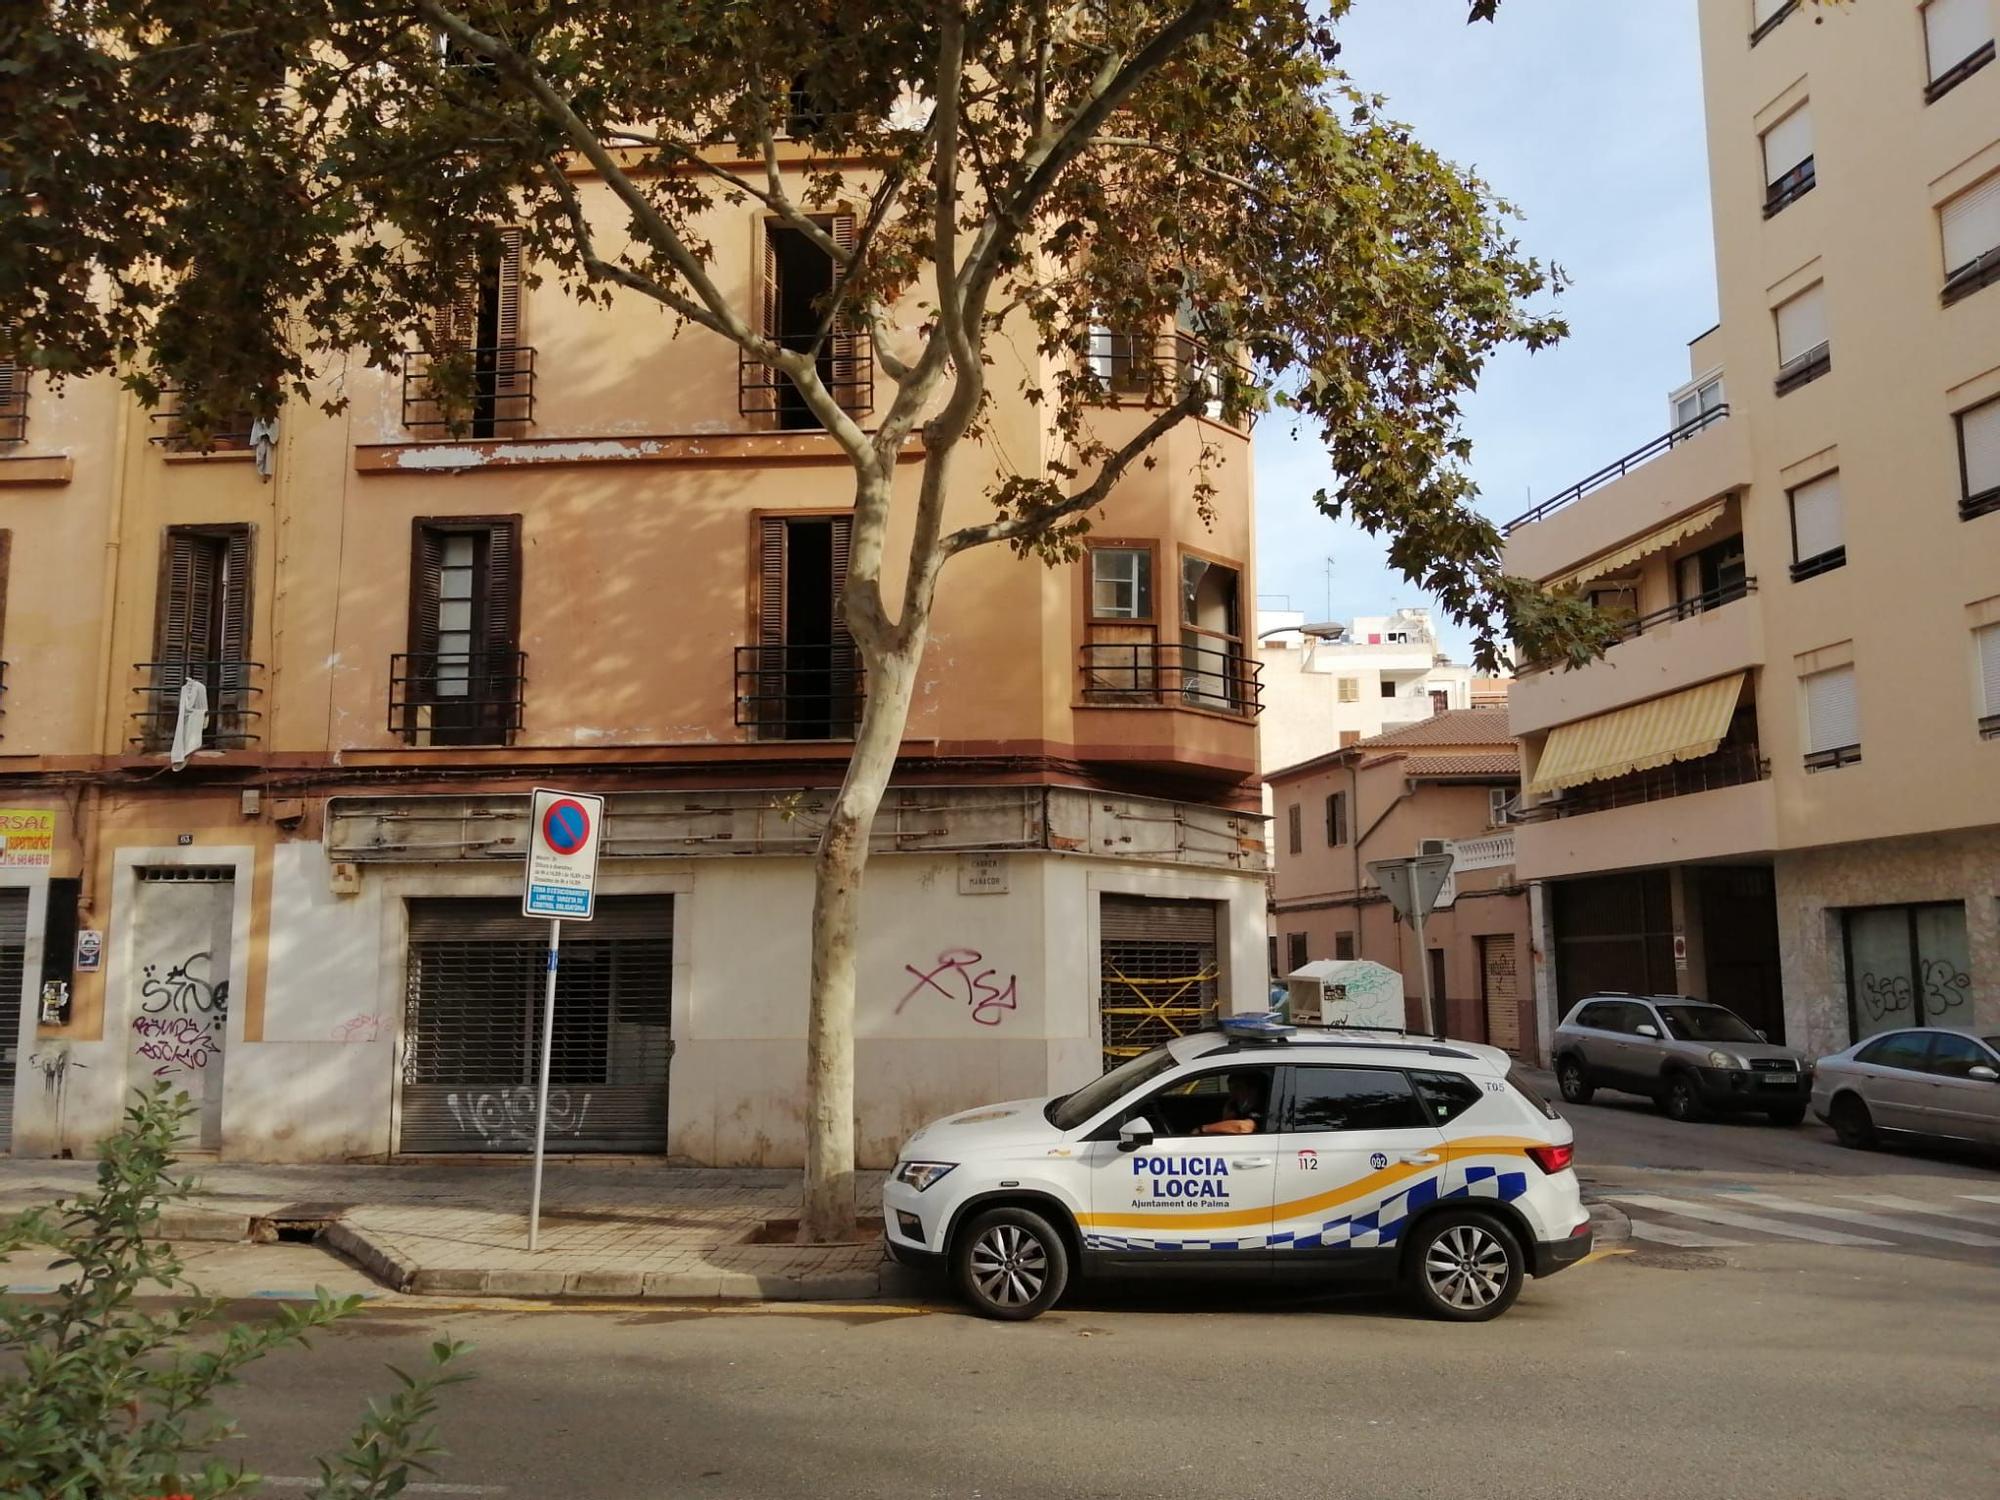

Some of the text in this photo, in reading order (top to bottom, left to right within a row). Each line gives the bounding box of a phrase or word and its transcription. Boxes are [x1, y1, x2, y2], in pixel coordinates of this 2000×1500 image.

[1133, 1157, 1229, 1176] POLICIA
[1299, 1158, 1318, 1170] 112
[1371, 1156, 1387, 1169] 092
[1153, 1179, 1230, 1198] LOCAL
[1131, 1200, 1230, 1208] Ajuntament de Palma
